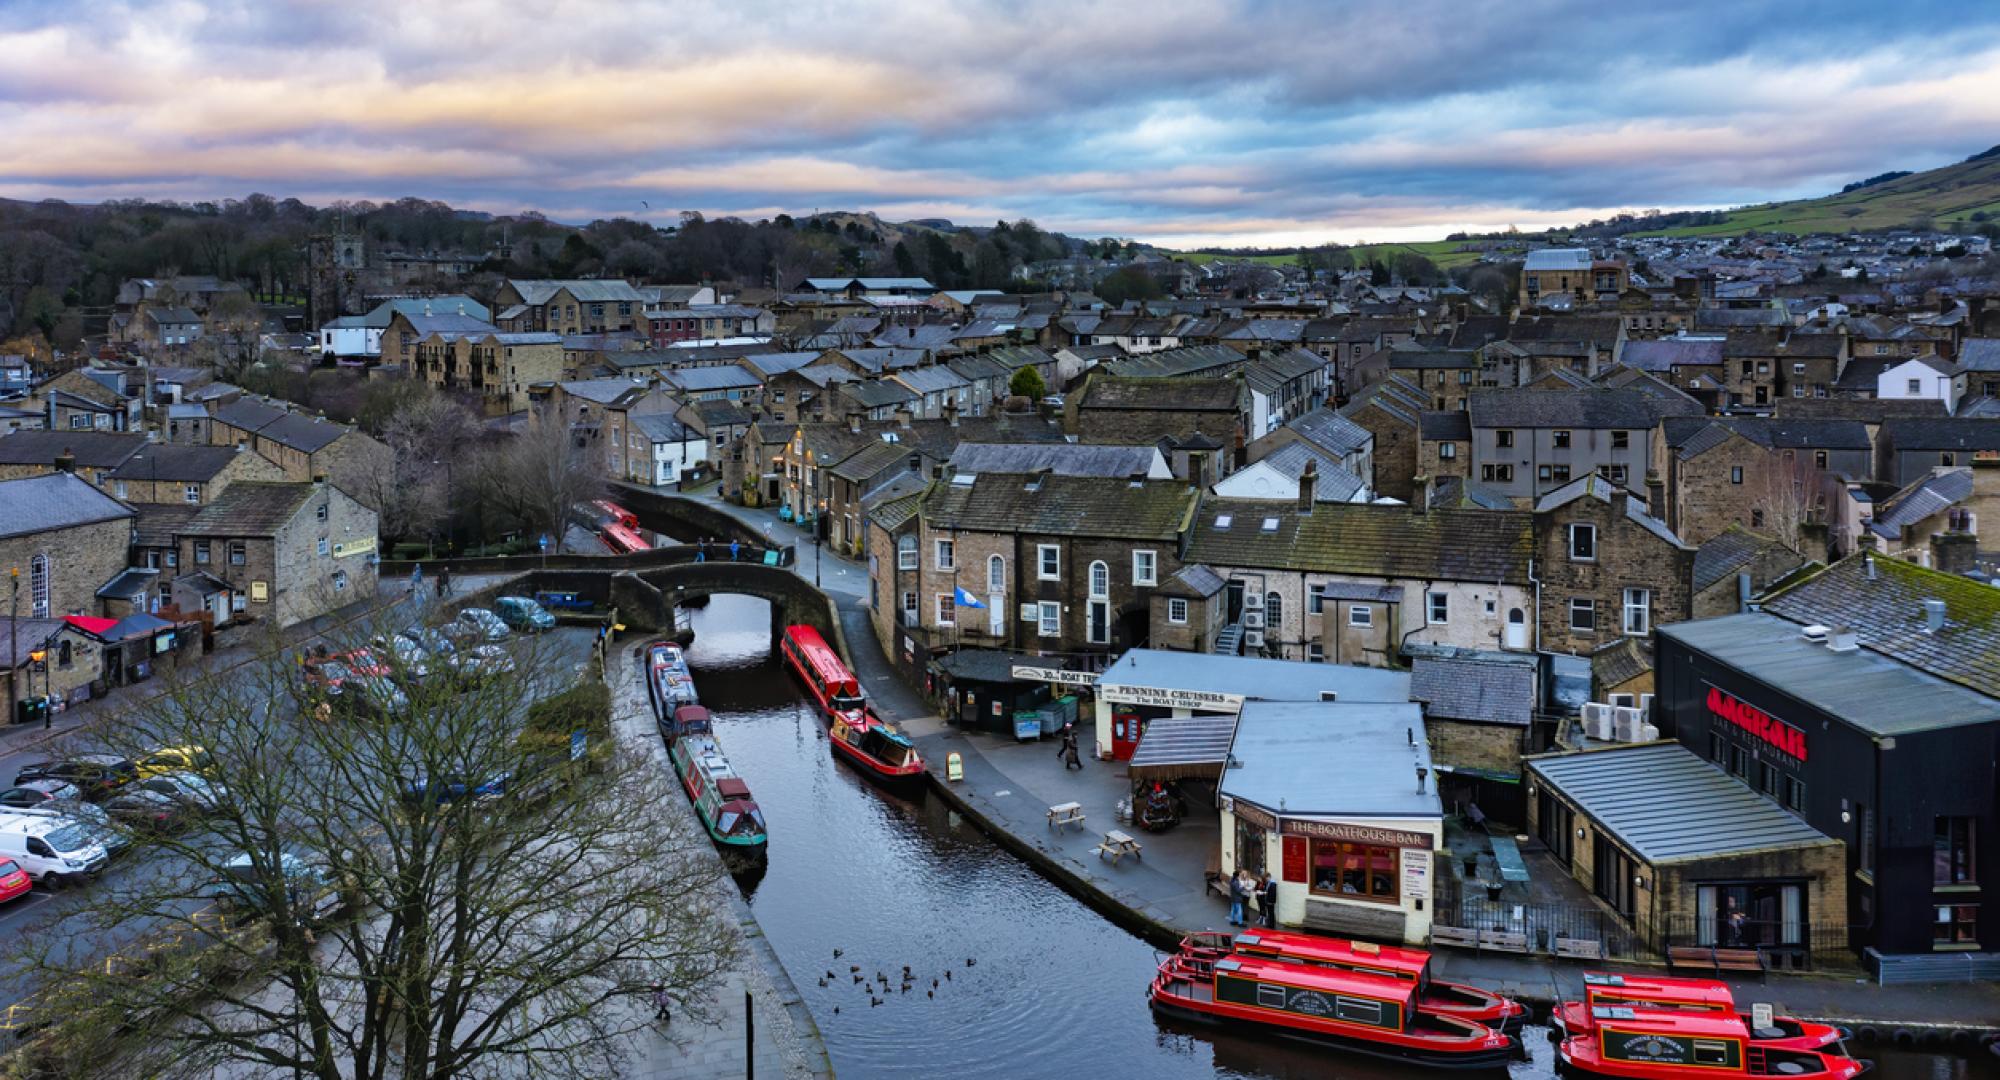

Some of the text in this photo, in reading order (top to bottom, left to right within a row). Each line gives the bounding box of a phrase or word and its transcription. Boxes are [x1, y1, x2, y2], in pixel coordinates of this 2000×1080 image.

[1119, 686, 1225, 702] PENNINE CRUISERS
[1291, 822, 1422, 845] THE BOATHOUSE BAR
